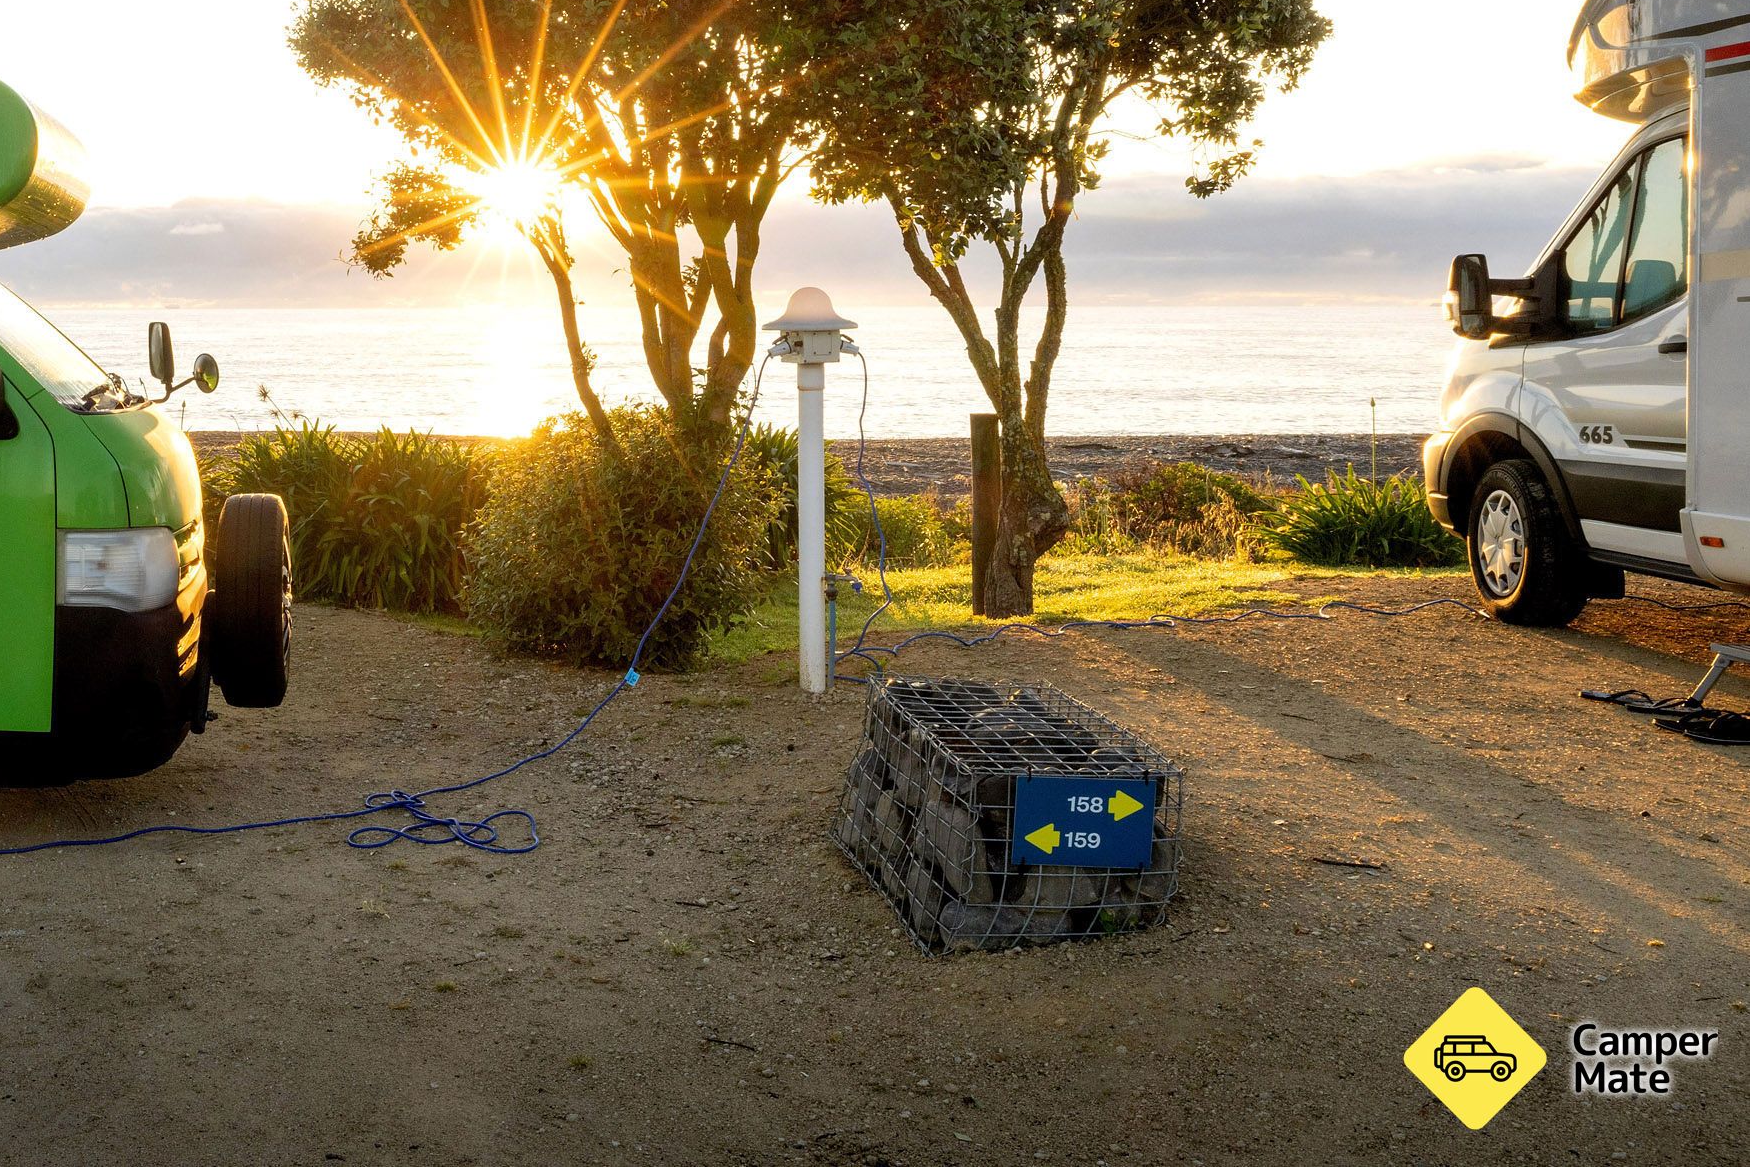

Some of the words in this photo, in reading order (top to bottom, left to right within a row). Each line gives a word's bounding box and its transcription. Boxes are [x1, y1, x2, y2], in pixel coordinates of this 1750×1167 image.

[1579, 425, 1613, 445] 665
[1067, 796, 1103, 813] 158
[1065, 832, 1101, 849] 159
